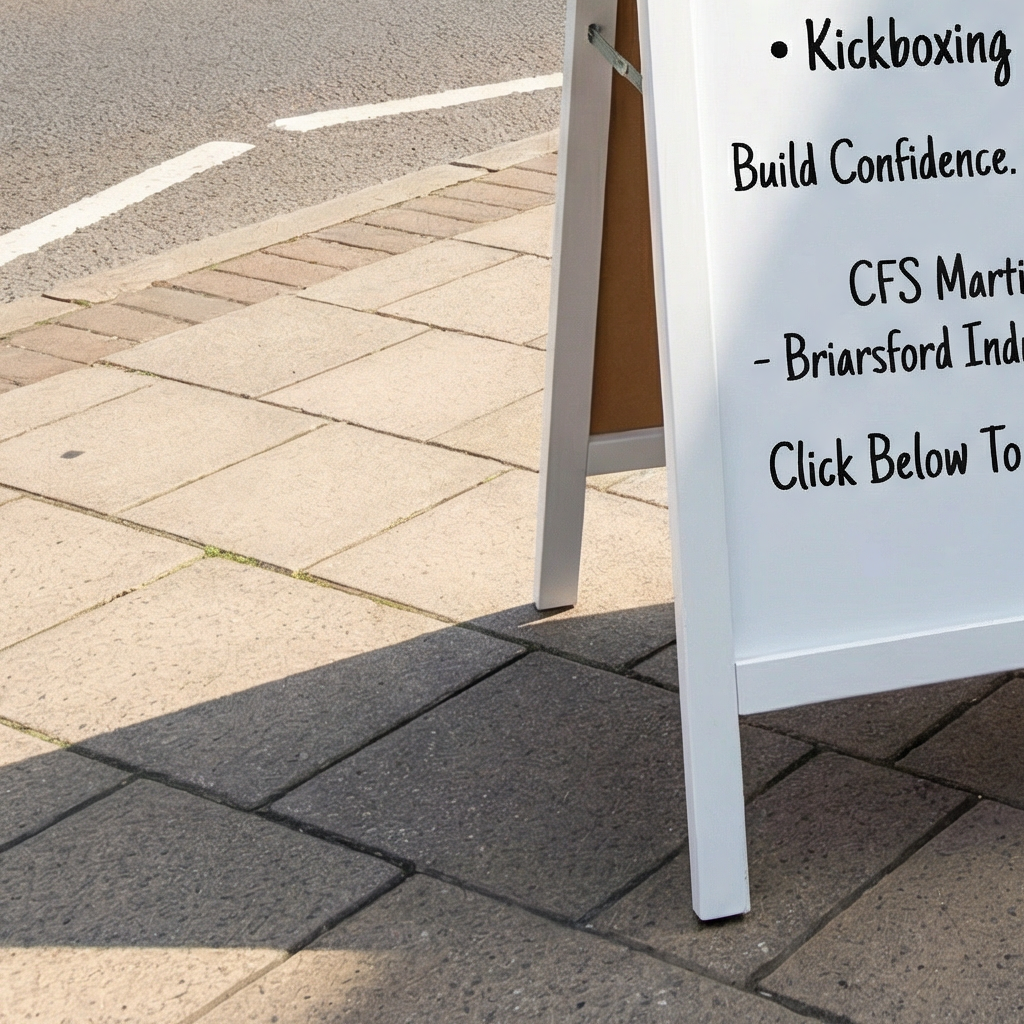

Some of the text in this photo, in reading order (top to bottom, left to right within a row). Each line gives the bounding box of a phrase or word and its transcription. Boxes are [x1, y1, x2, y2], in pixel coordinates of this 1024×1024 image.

[805, 17, 1013, 88] Kickboxing
[731, 138, 818, 193] Build
[829, 133, 1018, 187] Confidence.
[849, 256, 923, 308] CFS
[783, 325, 955, 383] Briarsford
[769, 432, 858, 493] Click
[867, 431, 969, 485] Below
[979, 424, 1022, 474] To
